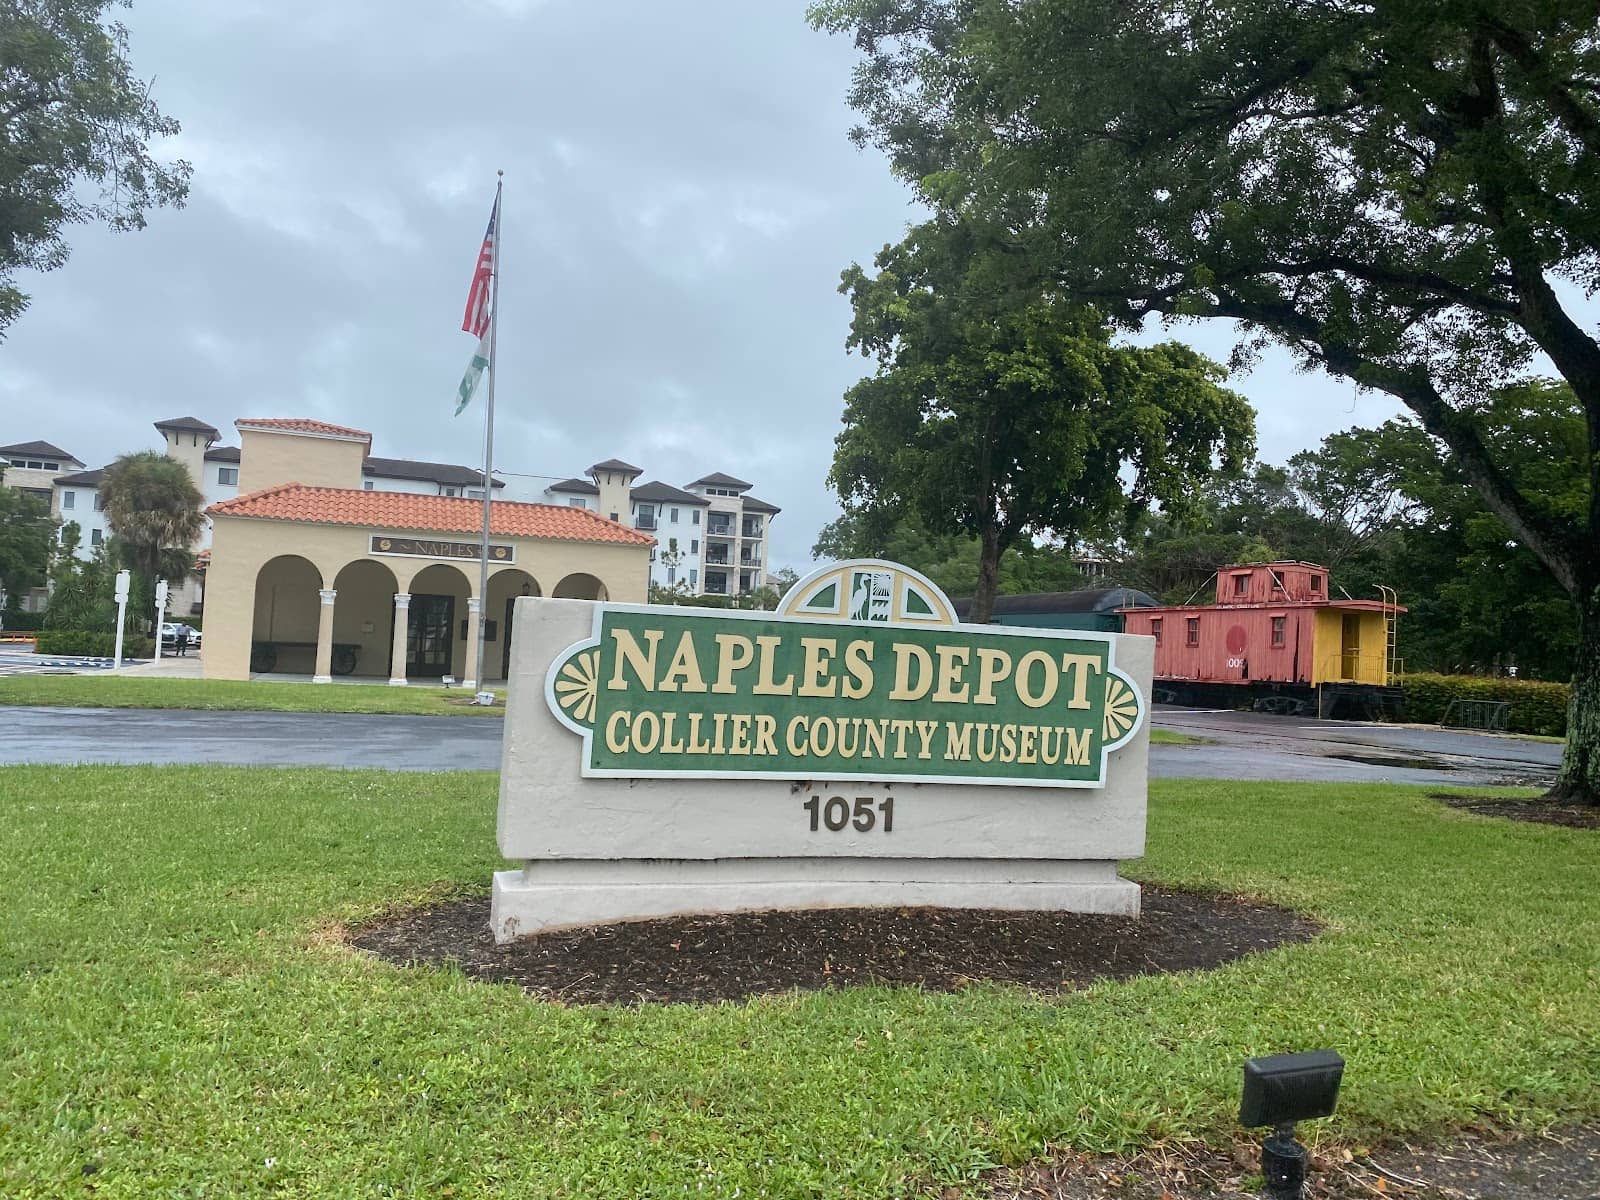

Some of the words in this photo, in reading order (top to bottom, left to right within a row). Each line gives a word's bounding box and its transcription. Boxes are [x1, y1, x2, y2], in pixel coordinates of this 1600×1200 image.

[415, 541, 474, 558] NAPLES
[606, 628, 875, 700] NAPLES
[889, 642, 1103, 710] DEPOT
[605, 710, 778, 756] COLLIER
[786, 715, 939, 760] COUNTY
[943, 721, 1093, 767] MUSEUM
[803, 795, 894, 833] 1051
